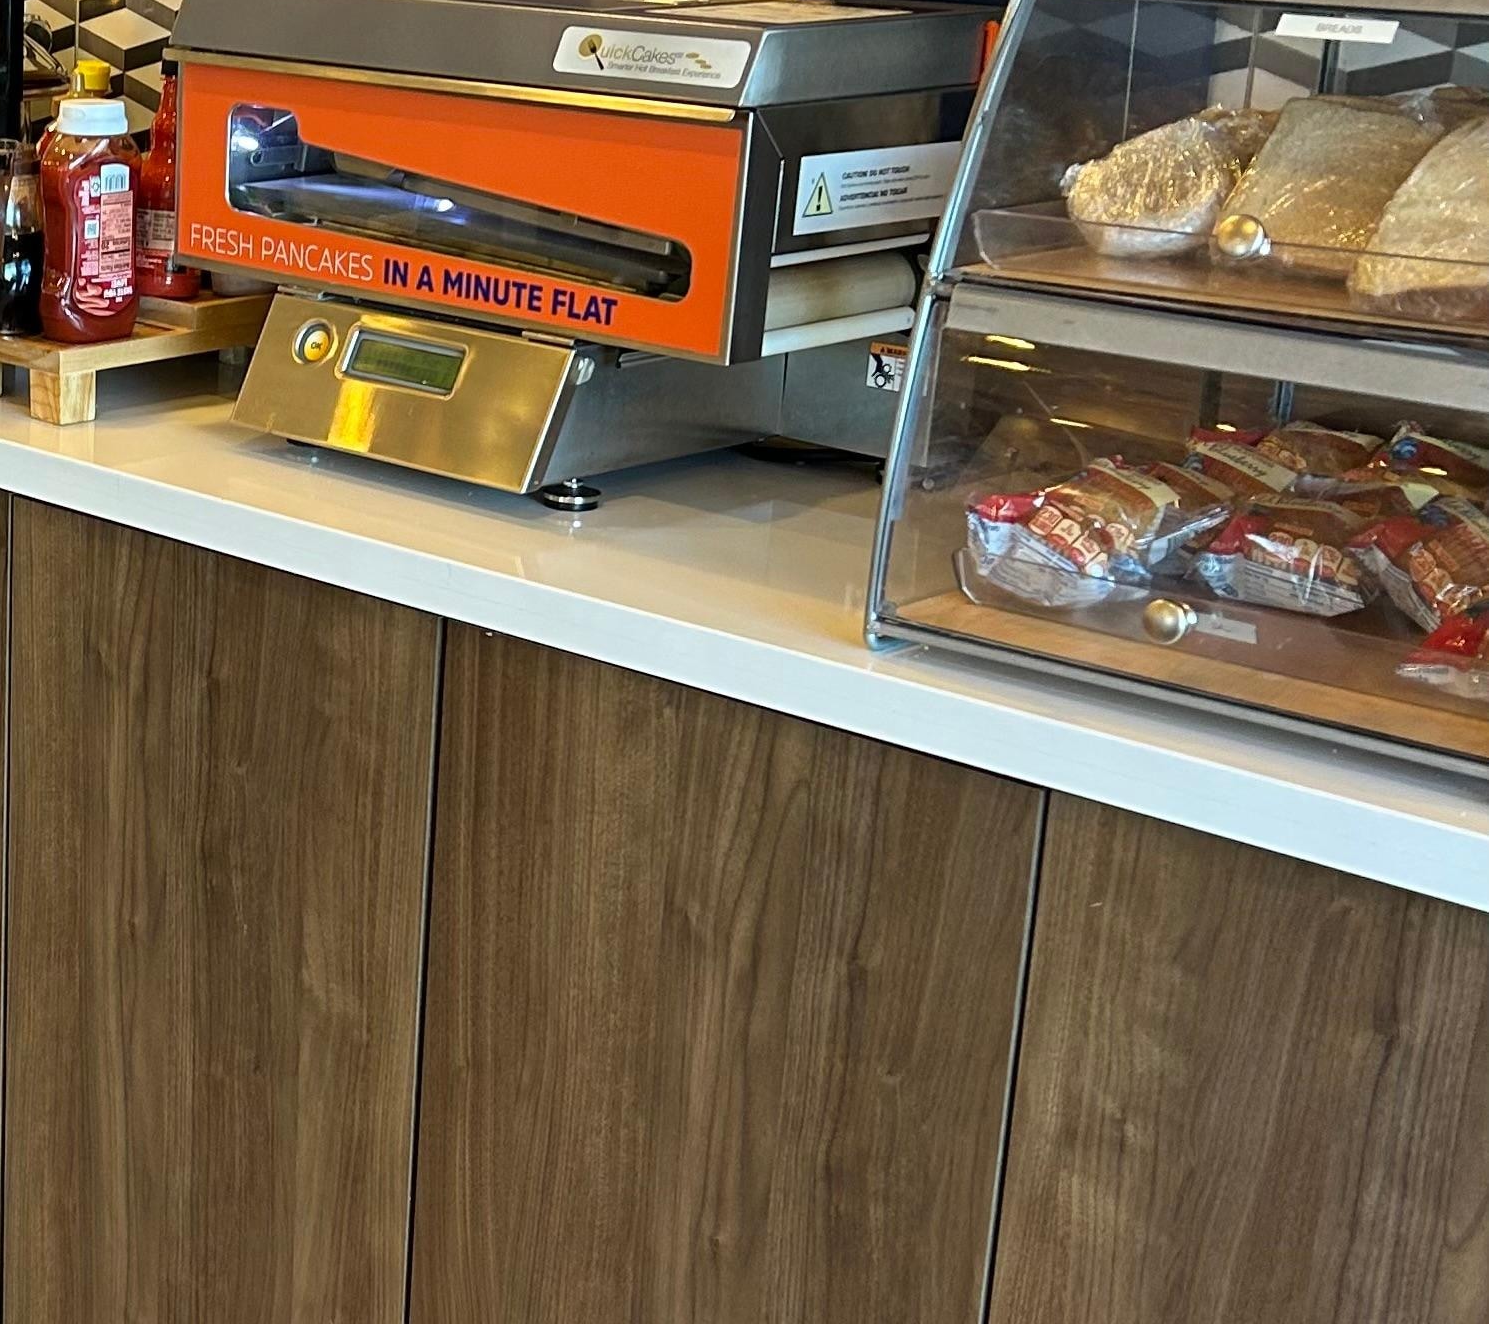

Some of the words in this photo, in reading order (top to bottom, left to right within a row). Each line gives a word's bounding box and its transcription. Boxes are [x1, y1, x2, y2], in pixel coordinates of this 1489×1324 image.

[190, 223, 253, 259] FRESH
[261, 237, 374, 281] PANCAKES
[383, 258, 410, 288] IN
[416, 267, 434, 292] A
[443, 271, 542, 312] MINUTE
[552, 288, 618, 326] FLAT
